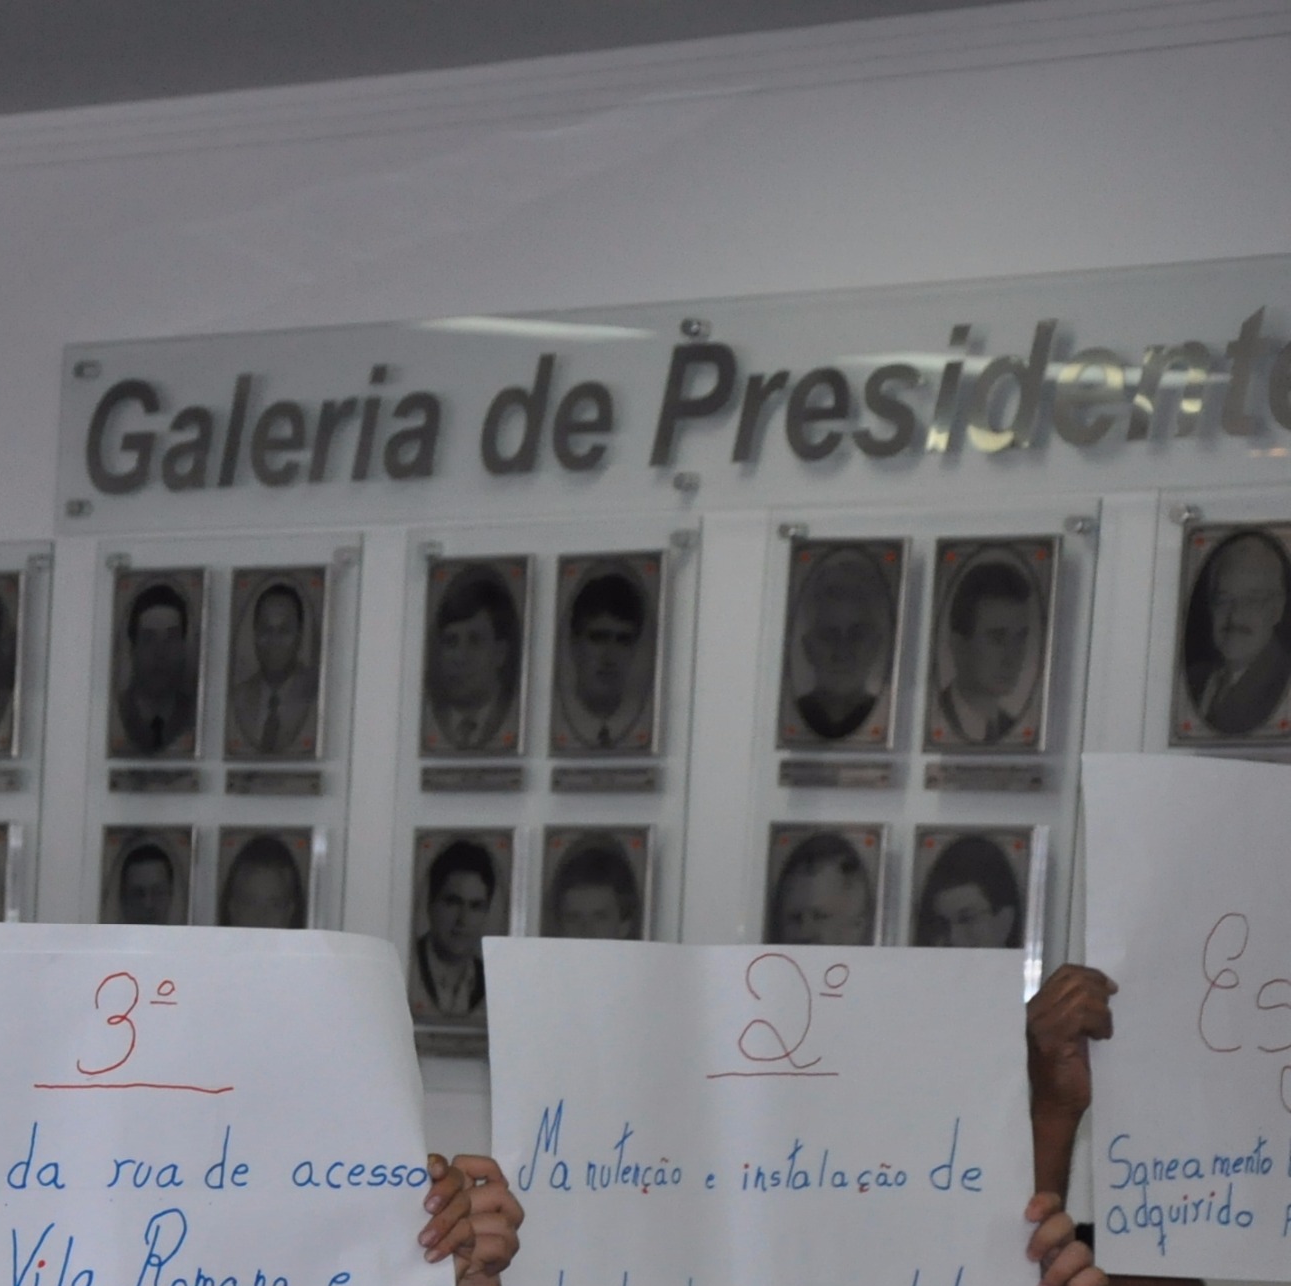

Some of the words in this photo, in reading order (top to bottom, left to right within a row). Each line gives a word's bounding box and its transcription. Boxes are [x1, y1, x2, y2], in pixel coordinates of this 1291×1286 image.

[85, 364, 441, 495] Galeria
[481, 353, 613, 474] de
[7, 1122, 66, 1190] da
[107, 1159, 184, 1188] rua
[204, 1125, 249, 1190] de
[292, 1161, 428, 1189] acesso
[519, 1099, 681, 1194] Manutenção
[704, 1173, 717, 1190] e
[743, 1139, 907, 1193] instalação
[930, 1118, 982, 1192] de
[1109, 1134, 1272, 1188] Saneamento
[1107, 1182, 1253, 1255] adquirido
